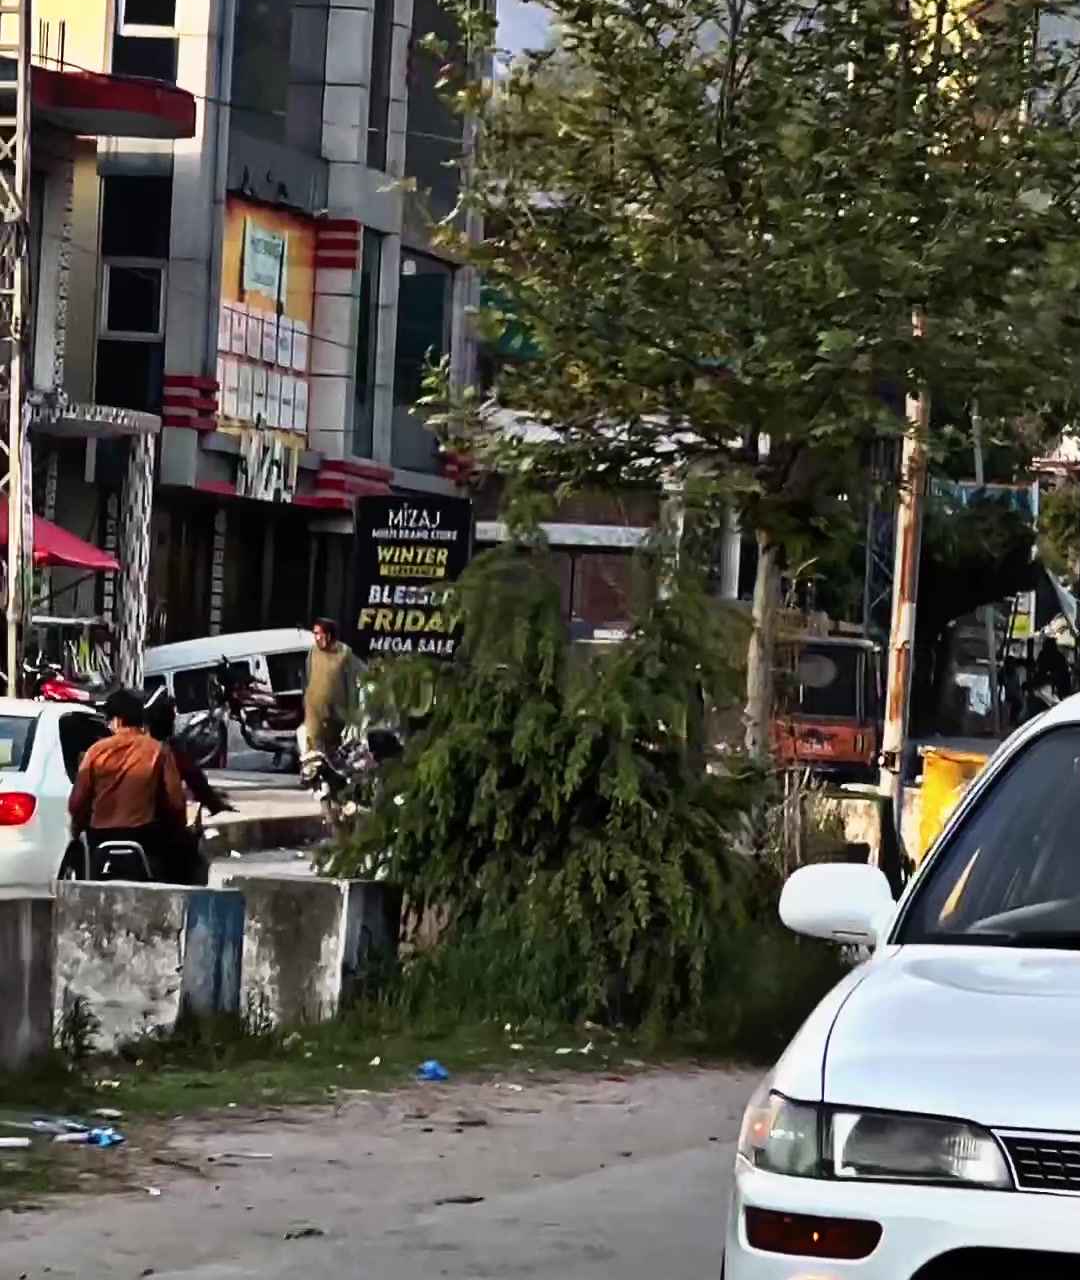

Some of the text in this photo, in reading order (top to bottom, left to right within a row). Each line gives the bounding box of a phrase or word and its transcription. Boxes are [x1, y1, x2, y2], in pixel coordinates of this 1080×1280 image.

[377, 545, 449, 565] WINTER
[357, 607, 461, 633] FRIDAY
[418, 638, 455, 654] SALE
